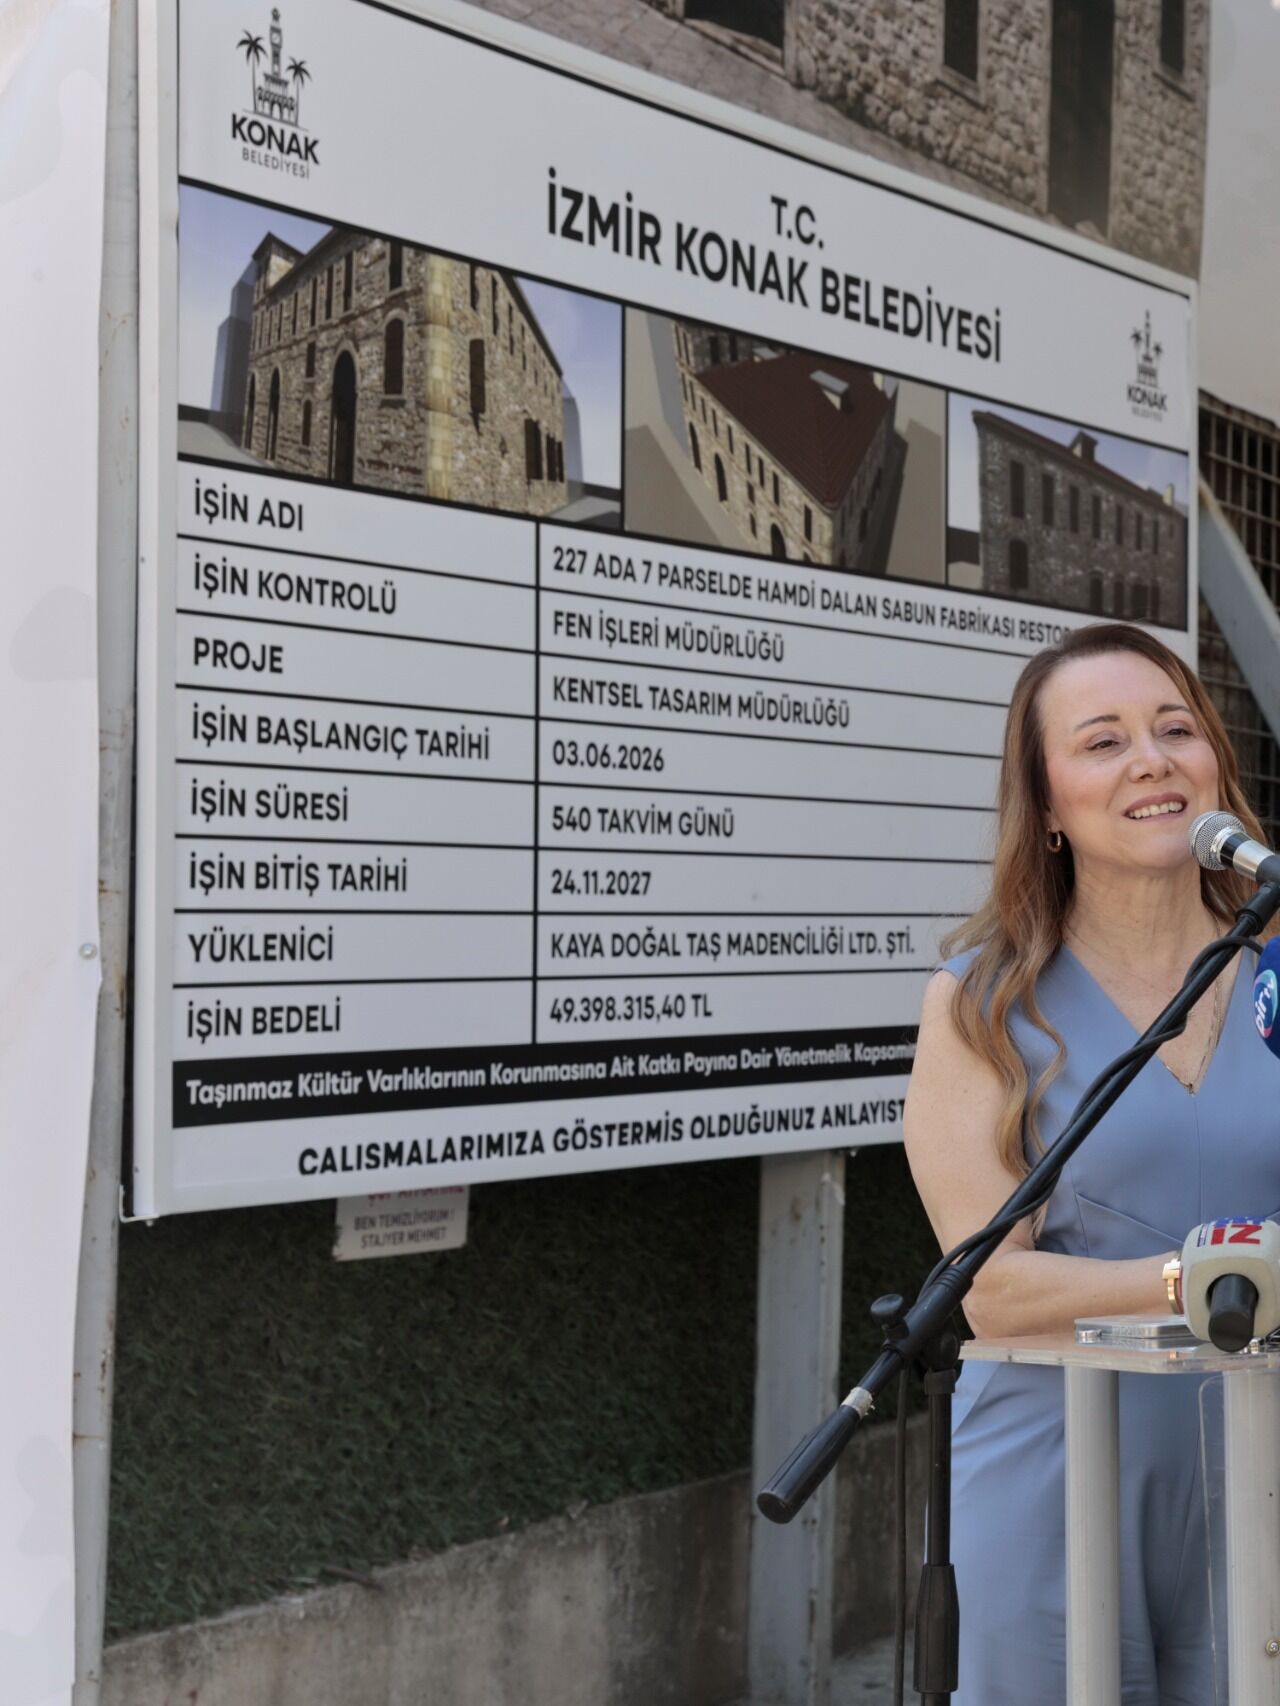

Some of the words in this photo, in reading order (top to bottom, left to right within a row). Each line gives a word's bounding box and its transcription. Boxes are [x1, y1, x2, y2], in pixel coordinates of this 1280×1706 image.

[231, 112, 320, 165] KONAK
[242, 147, 310, 180] BELEDİYESİ
[770, 195, 825, 251] T.C.
[547, 165, 662, 266] İZMİR
[674, 222, 809, 308] KONAK
[820, 267, 1001, 363] BELEDİYESİ
[194, 477, 249, 525] İŞİN
[257, 498, 304, 532] ADI
[194, 553, 249, 600] İŞİN
[257, 569, 397, 615] KONTROLÜ
[553, 546, 588, 574] 227
[593, 554, 637, 583] ADA
[642, 560, 653, 585] 7
[658, 561, 753, 599] PARSELDE
[757, 578, 816, 610] HAMDİ
[820, 588, 878, 618] DALAN
[882, 597, 937, 626] SABUN
[940, 605, 1016, 639] FABRİKASI
[193, 637, 284, 674] PROJE
[553, 610, 593, 640] FEN
[599, 609, 660, 649] İŞLERİ
[664, 620, 785, 663] MÜDÜRLÜĞÜ
[553, 676, 644, 709] KENTSEL
[648, 685, 733, 717] TASARIM
[738, 691, 850, 728] MÜDÜRLÜĞÜ
[192, 702, 248, 748] İŞİN
[256, 715, 409, 760] BAŞLANGIÇ
[415, 723, 490, 761] TARİHİ
[552, 739, 665, 772] 03.06.2026
[190, 778, 247, 824] İŞİN
[254, 780, 349, 822] SÜRESİ
[551, 805, 592, 832] 540
[597, 802, 673, 836] TAKVİM
[678, 806, 735, 839] GÜNÜ
[189, 851, 246, 896] İŞİN
[254, 853, 321, 898] BİTİŞ
[327, 857, 408, 893] TARİHİ
[551, 869, 652, 896] 24.11.2027
[188, 924, 334, 963] YÜKLENİCİ
[550, 932, 605, 960] KAYA
[611, 926, 682, 958] DOĞAL
[686, 932, 722, 963] TAŞ
[726, 925, 844, 957] MADENCİLİĞİ
[848, 931, 882, 956] LTD.
[886, 926, 915, 960] ŞTİ.
[187, 1000, 243, 1044] İŞİN
[251, 996, 341, 1036] BEDELİ
[549, 993, 687, 1023] 49.398.315,40
[690, 993, 713, 1018] TL
[186, 1078, 293, 1109] Taşınmaz
[297, 1070, 363, 1098] Kültür
[366, 1065, 487, 1093] Varlıklarının
[489, 1060, 607, 1086] Korunmasına
[609, 1054, 636, 1078] Ait
[638, 1053, 682, 1076] Katkı
[683, 1052, 738, 1077] Payına
[740, 1048, 773, 1070] Dair
[774, 1043, 852, 1067] Yönetmelik
[297, 1129, 546, 1176] CALISMALARIMIZA
[553, 1110, 684, 1153] GÖSTERMİS
[690, 1103, 815, 1140] OLDUĞUNUZ
